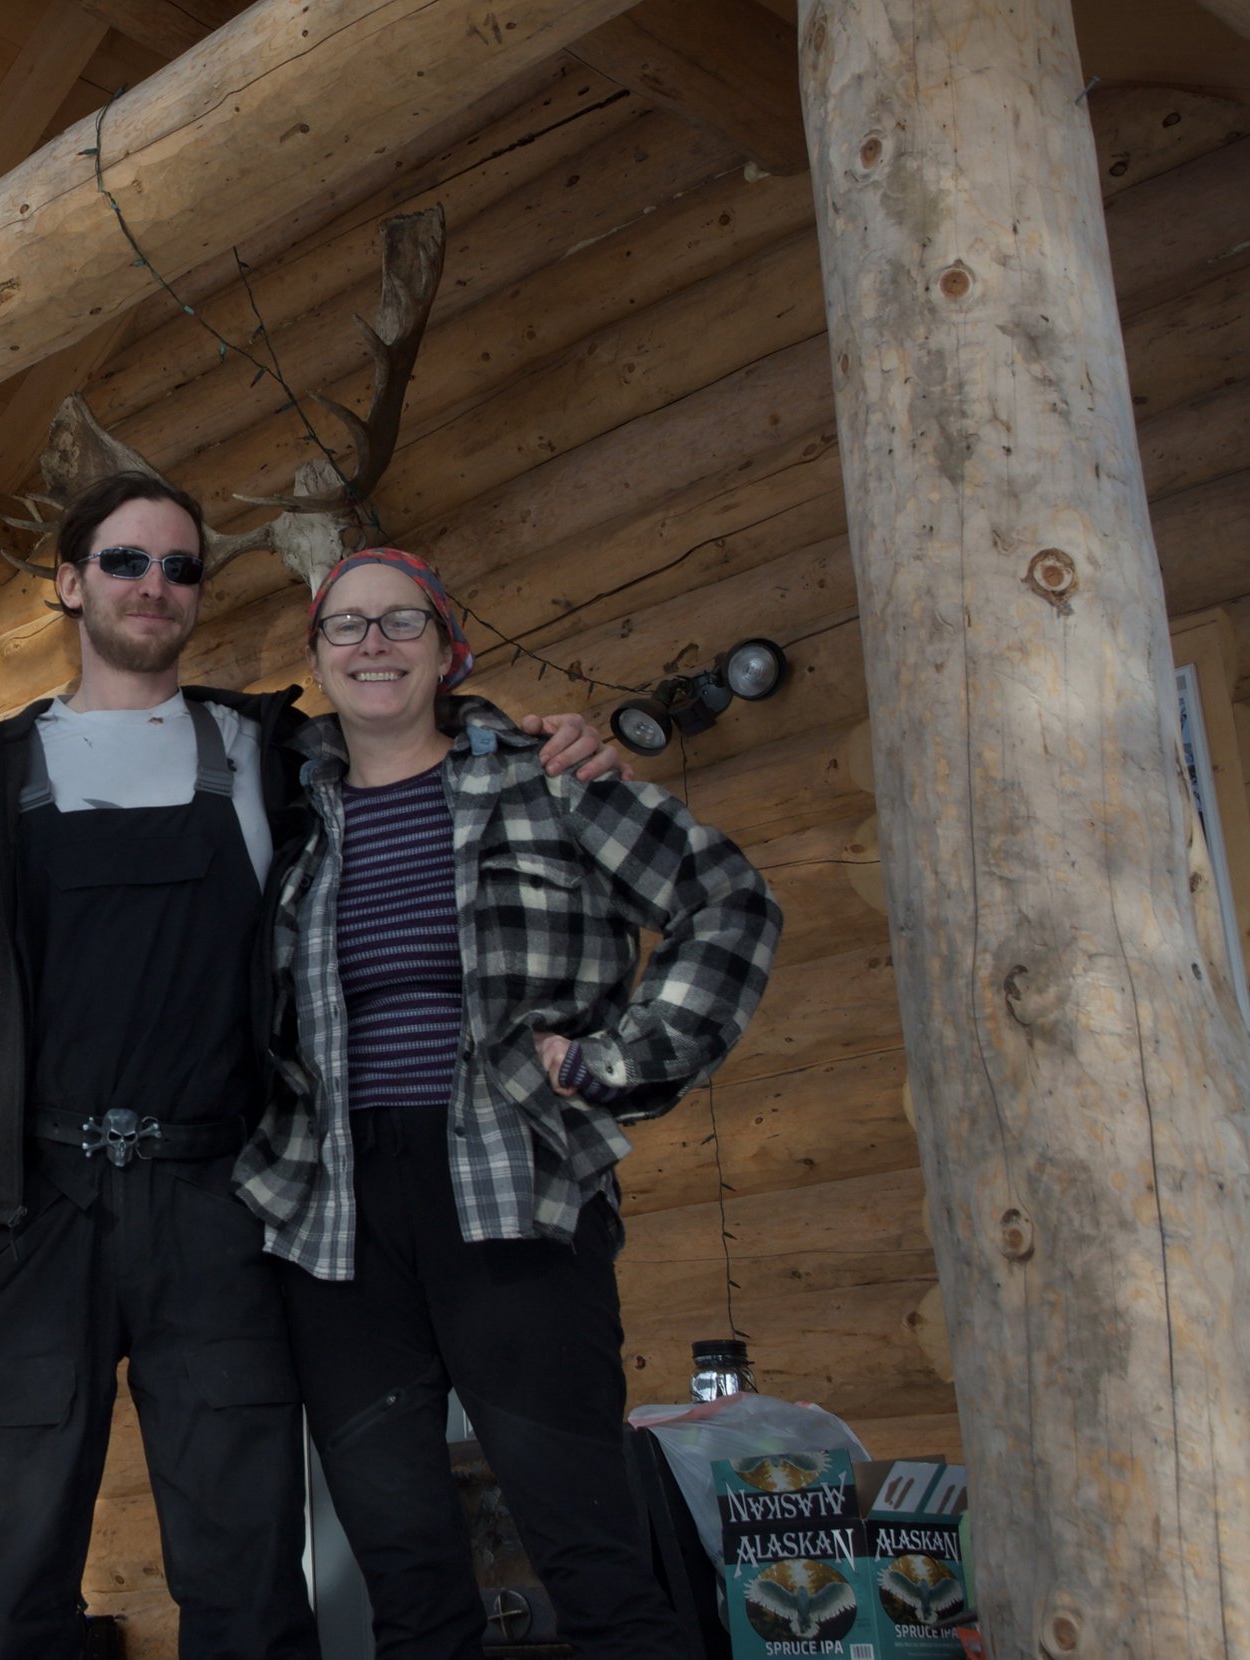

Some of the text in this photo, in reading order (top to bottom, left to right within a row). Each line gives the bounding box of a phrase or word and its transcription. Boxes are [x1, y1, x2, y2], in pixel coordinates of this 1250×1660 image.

[725, 1470, 847, 1523] ALASKAN
[733, 1528, 856, 1579] ALASKAN
[874, 1528, 960, 1565] ALASKAN
[766, 1640, 844, 1656] SPRUCE IPA
[895, 1624, 938, 1639] SPRUCE
